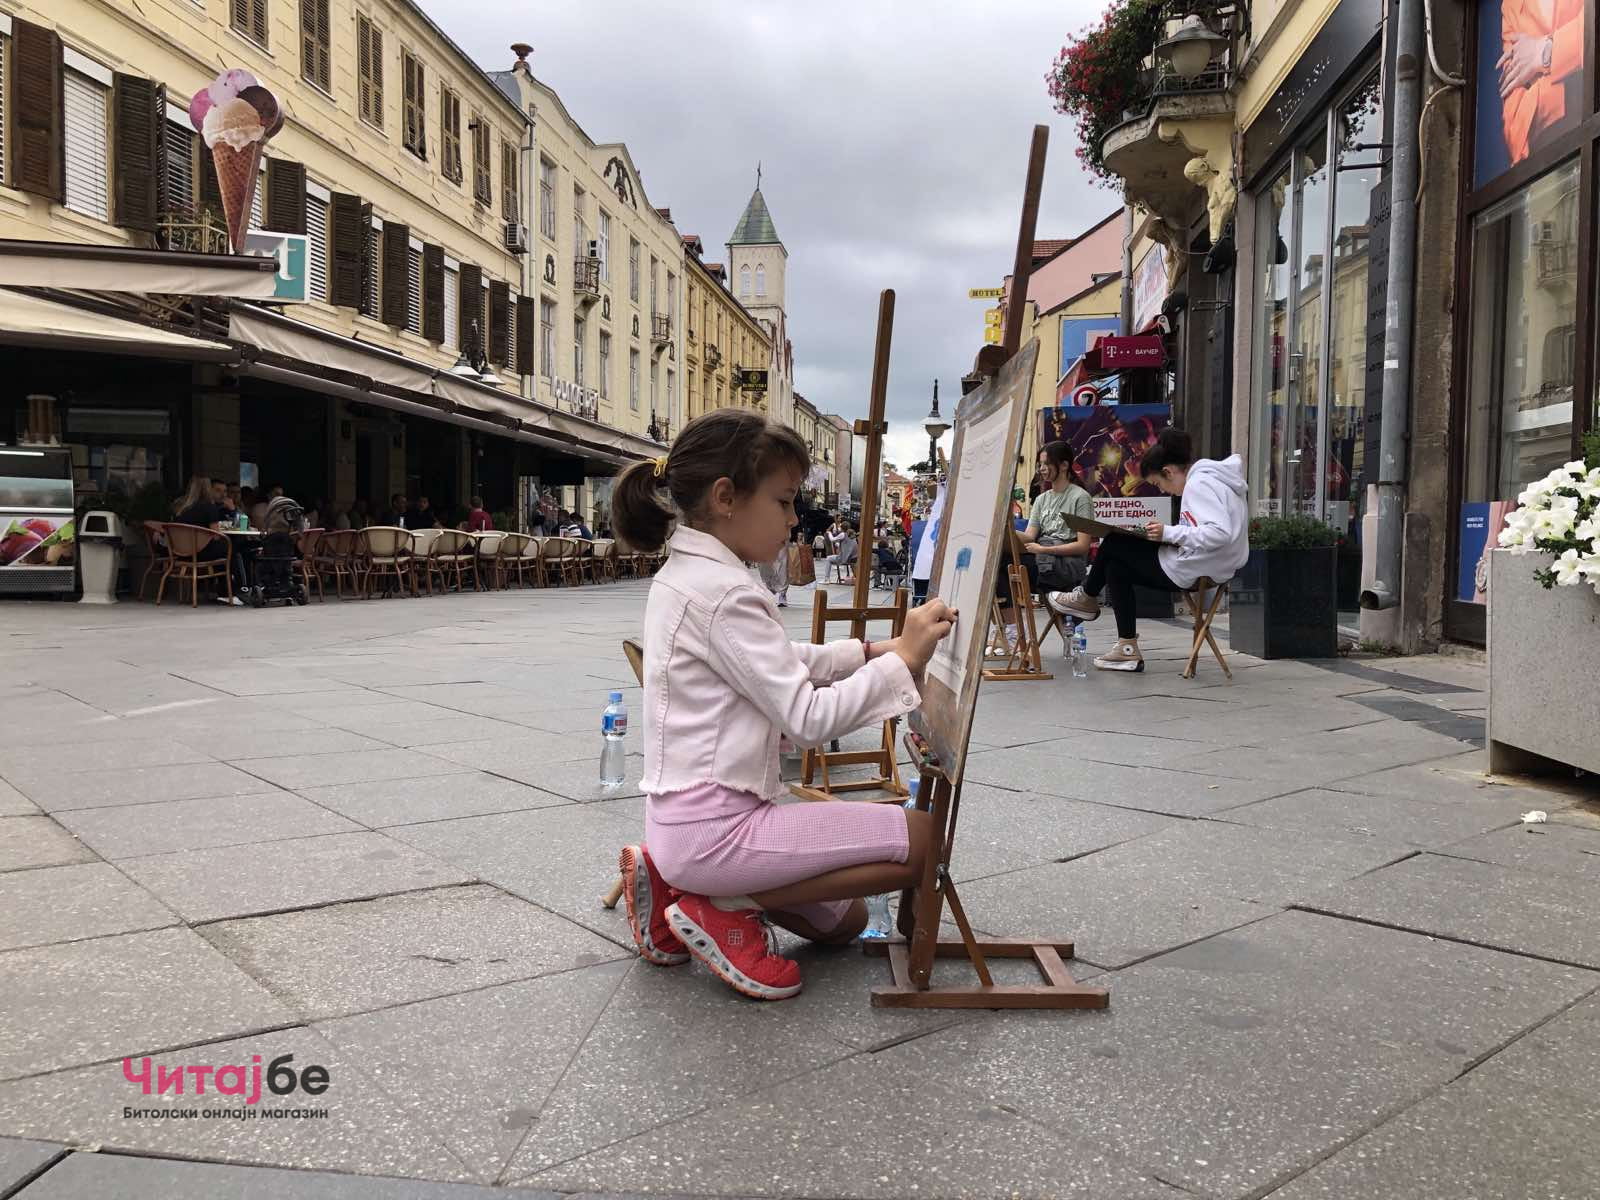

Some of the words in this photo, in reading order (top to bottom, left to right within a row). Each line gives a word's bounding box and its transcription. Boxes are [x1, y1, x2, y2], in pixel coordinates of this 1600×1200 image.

[1093, 501, 1112, 509] ОРИ
[1114, 500, 1145, 509] ЕДНО,
[1126, 509, 1157, 518] ЕДНО!
